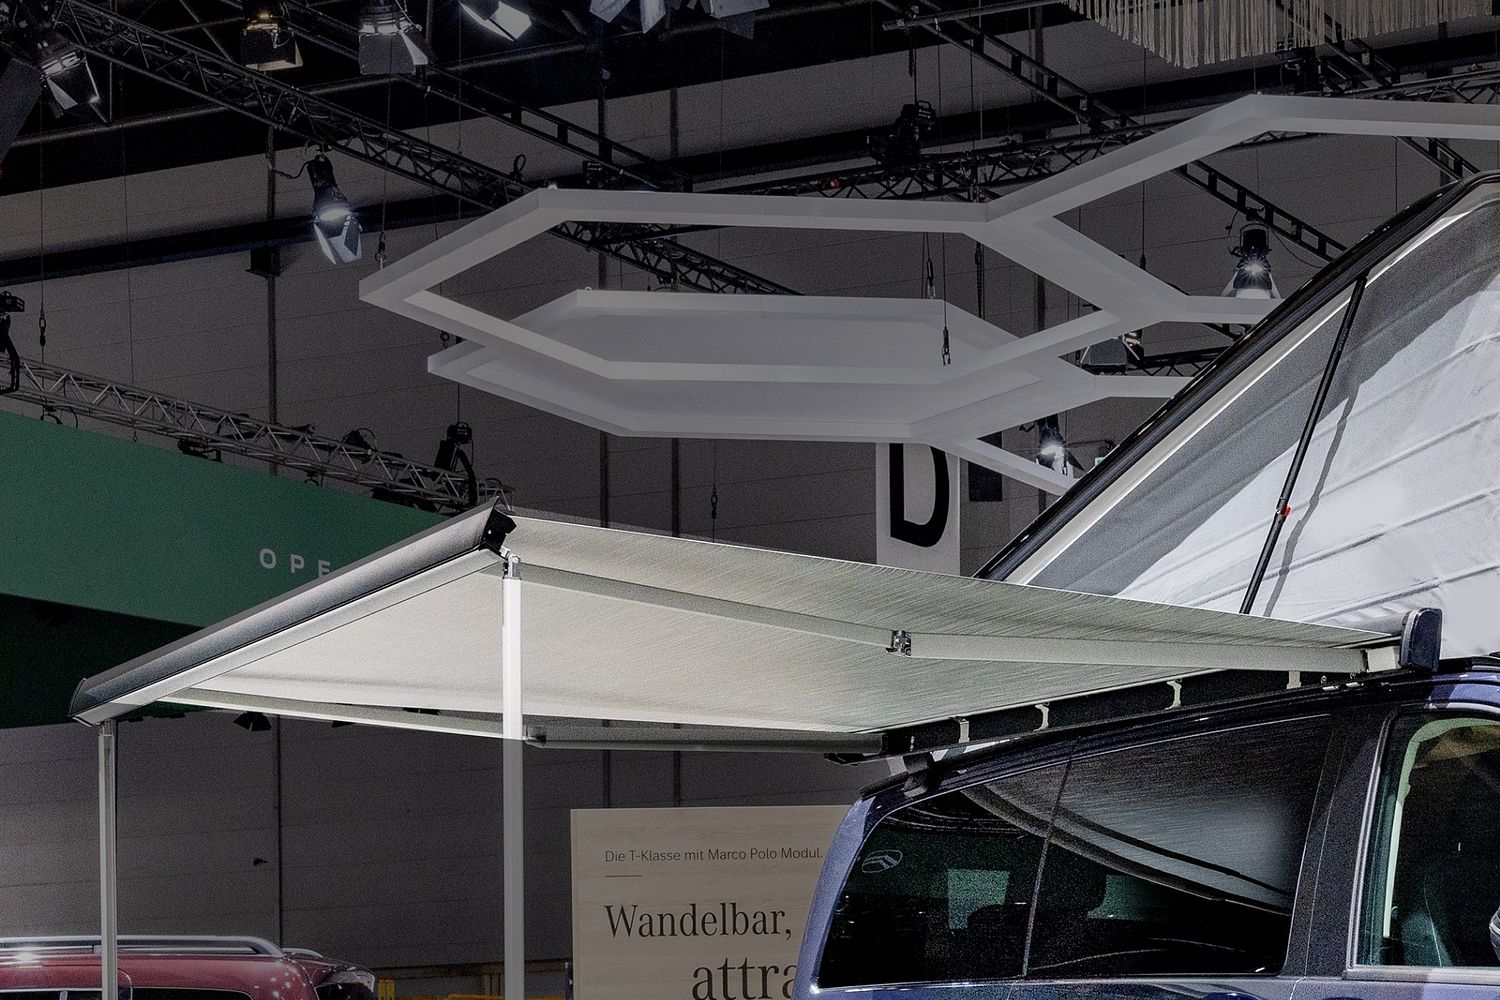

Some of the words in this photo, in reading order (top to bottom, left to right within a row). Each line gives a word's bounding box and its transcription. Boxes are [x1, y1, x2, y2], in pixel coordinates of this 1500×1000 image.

[260, 548, 330, 577] OPE
[605, 850, 625, 862] Die
[628, 849, 681, 862] T-Klasse
[685, 849, 704, 861] mit
[708, 848, 747, 861] Marco
[750, 848, 777, 860] Polo
[781, 847, 823, 859] Modul.
[604, 902, 792, 941] Wandelbar,
